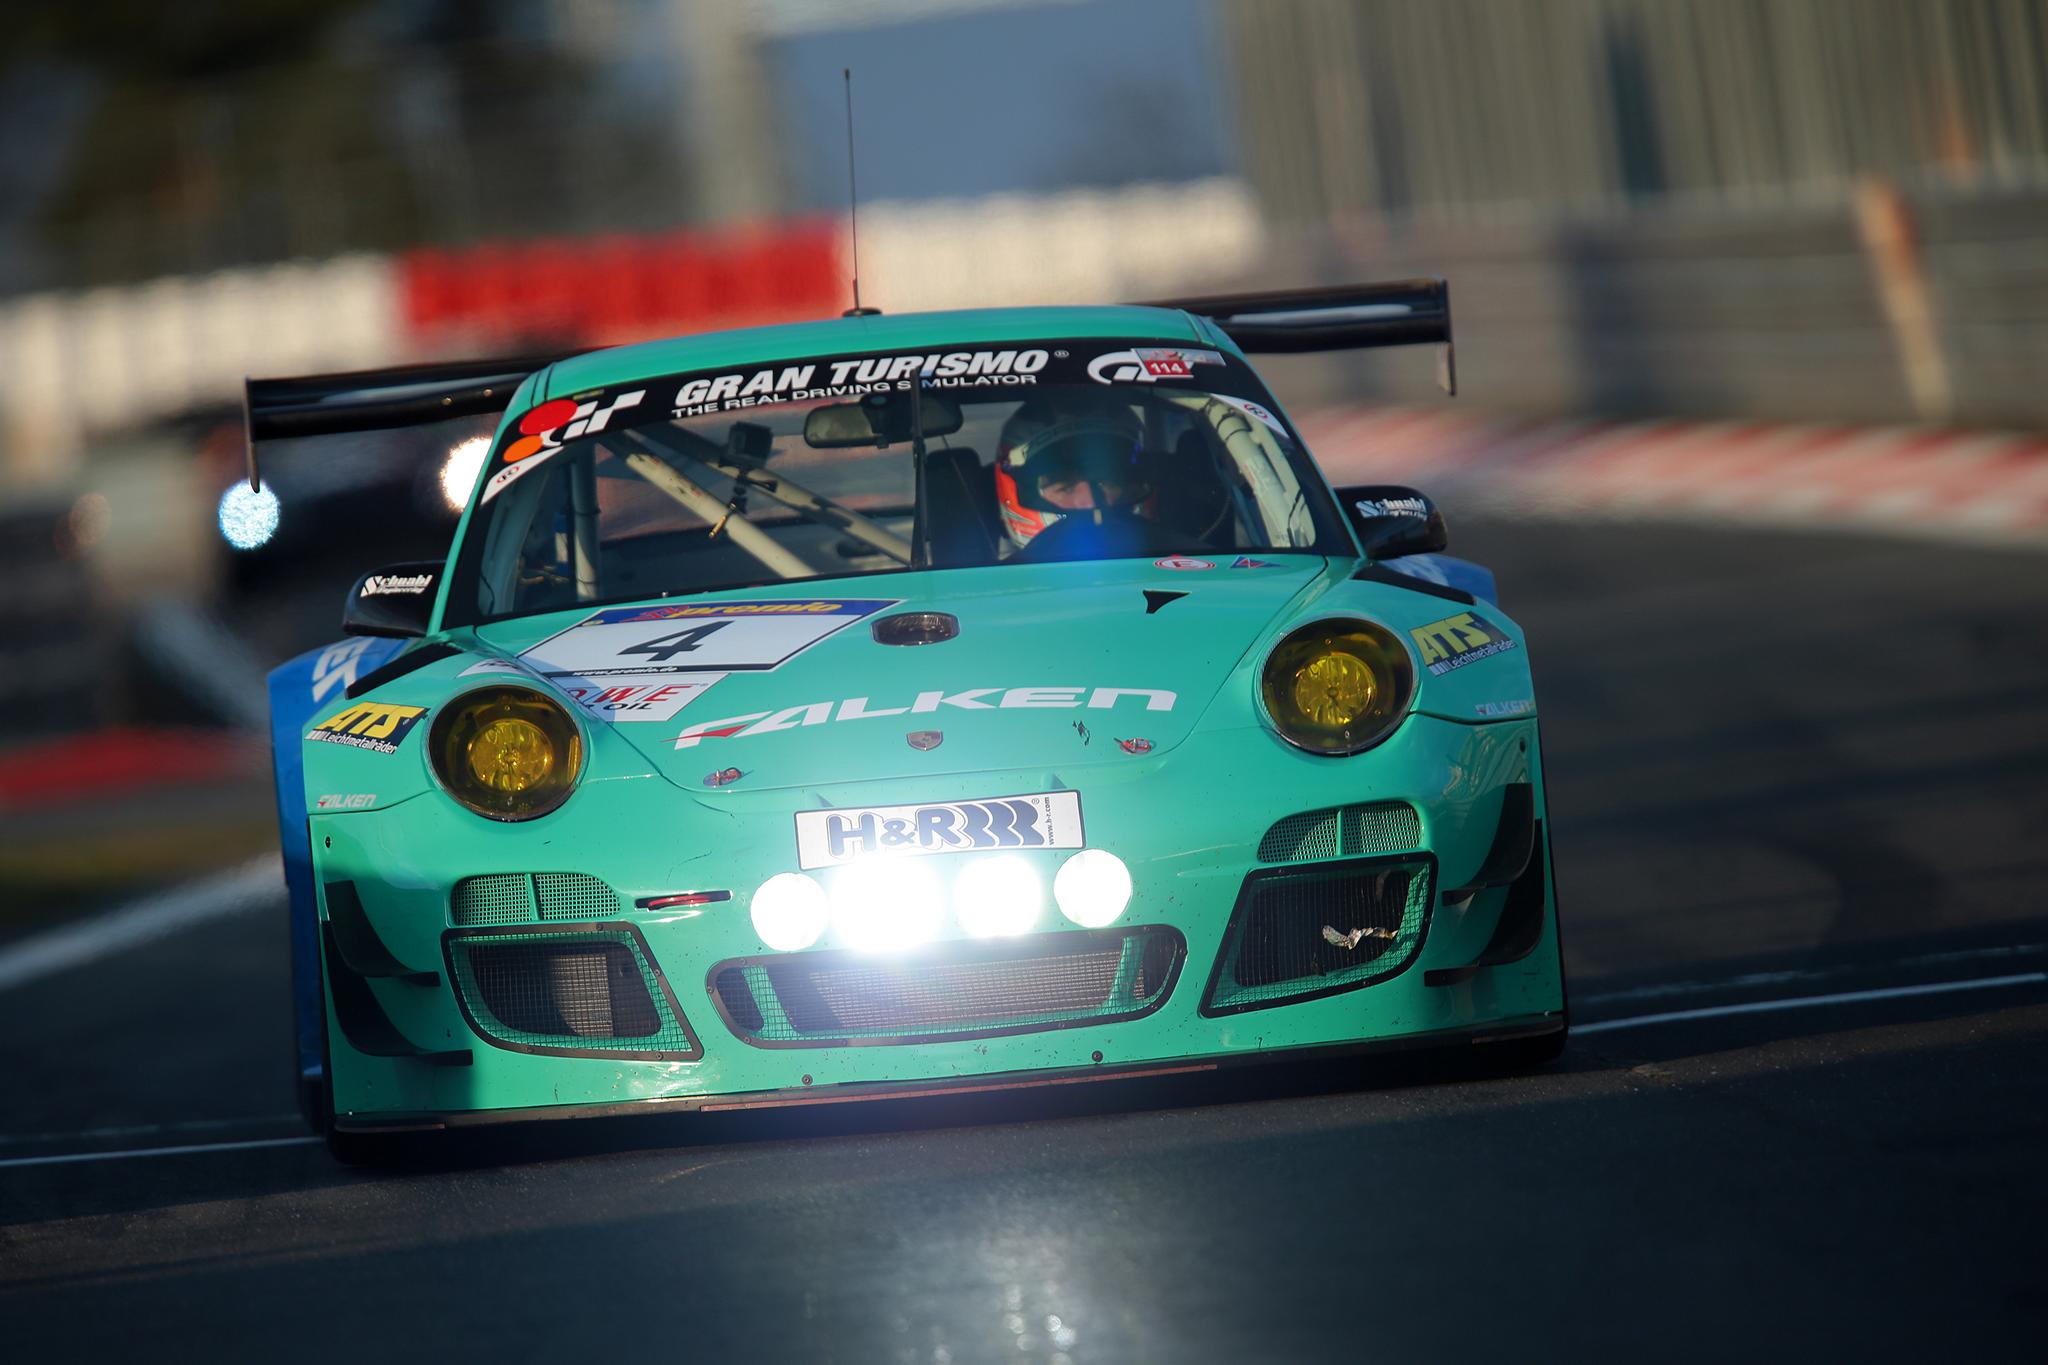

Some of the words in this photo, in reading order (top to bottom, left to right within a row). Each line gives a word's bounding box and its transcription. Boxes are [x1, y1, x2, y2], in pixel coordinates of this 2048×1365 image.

[674, 364, 816, 406] GRAN
[830, 350, 1050, 384] TURISMO
[1150, 362, 1184, 374] 114
[672, 402, 718, 418] THE
[725, 393, 787, 410] REAL
[792, 382, 890, 400] DRIVING
[897, 375, 1037, 392] SMULATOR
[665, 602, 843, 618] premio
[616, 619, 735, 662] 4
[1410, 613, 1491, 666] ATS
[311, 702, 426, 739] ATS
[603, 702, 653, 711] OIL
[662, 686, 1178, 750] FALKEN
[322, 730, 399, 754] Leichtmetallräder
[317, 794, 377, 809] FALKEN
